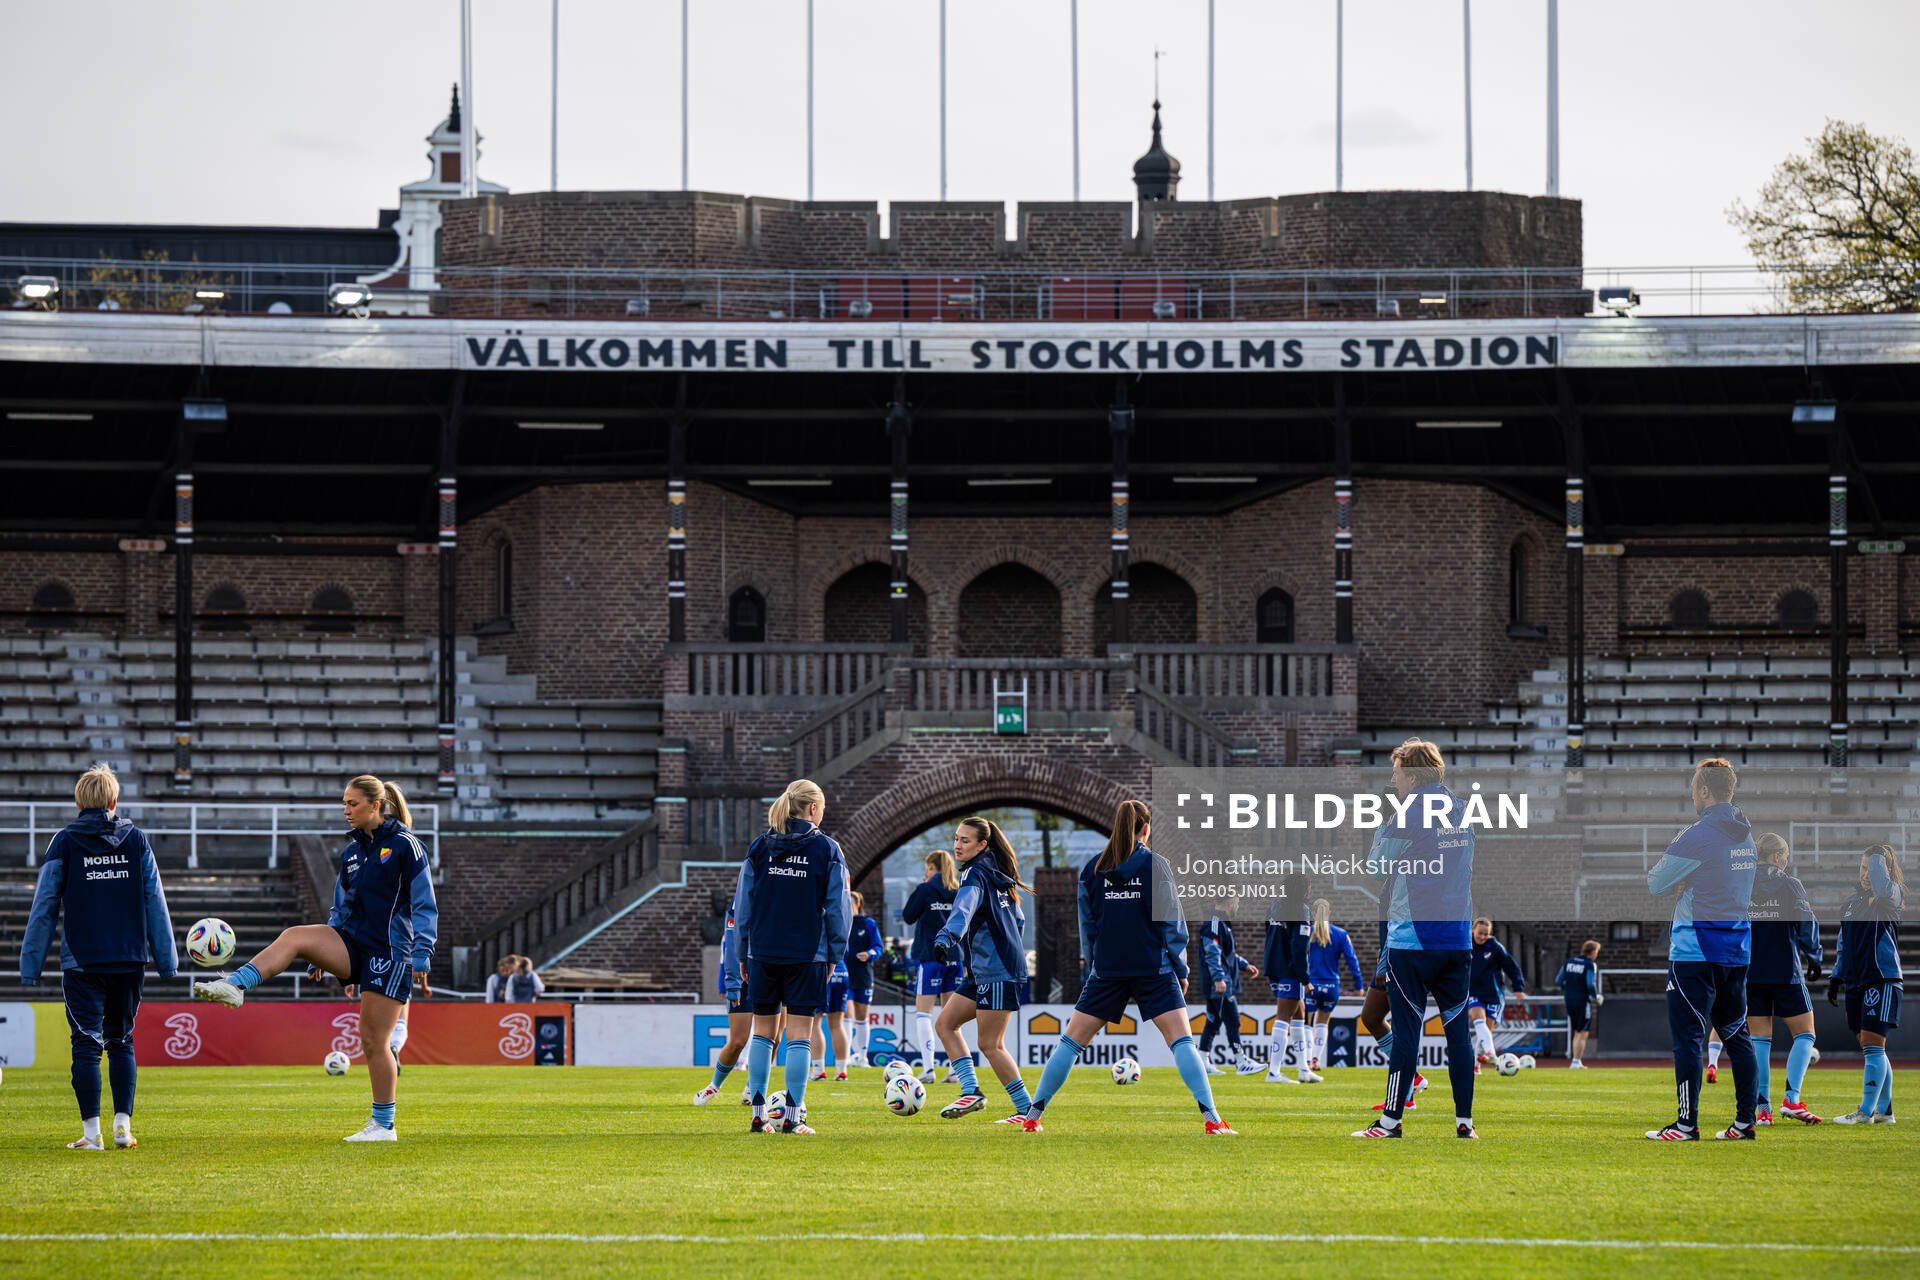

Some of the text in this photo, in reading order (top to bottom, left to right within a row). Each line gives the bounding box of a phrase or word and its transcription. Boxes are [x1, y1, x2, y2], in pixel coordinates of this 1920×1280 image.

[465, 329, 1558, 369] VÄLKOMMEN TILL STOCKHOLMS STADION
[1555, 693, 1565, 703] 19
[1550, 716, 1561, 726] 18
[1546, 739, 1556, 749] 17
[463, 764, 474, 774] 14
[1532, 809, 1542, 819] 14
[1730, 848, 1754, 859] MOBILL
[84, 854, 129, 867] MOBILL
[86, 870, 129, 880] stadium
[768, 866, 807, 878] stadium
[1104, 890, 1141, 900] stadium
[164, 1013, 201, 1059] 3
[498, 1013, 535, 1059] 3
